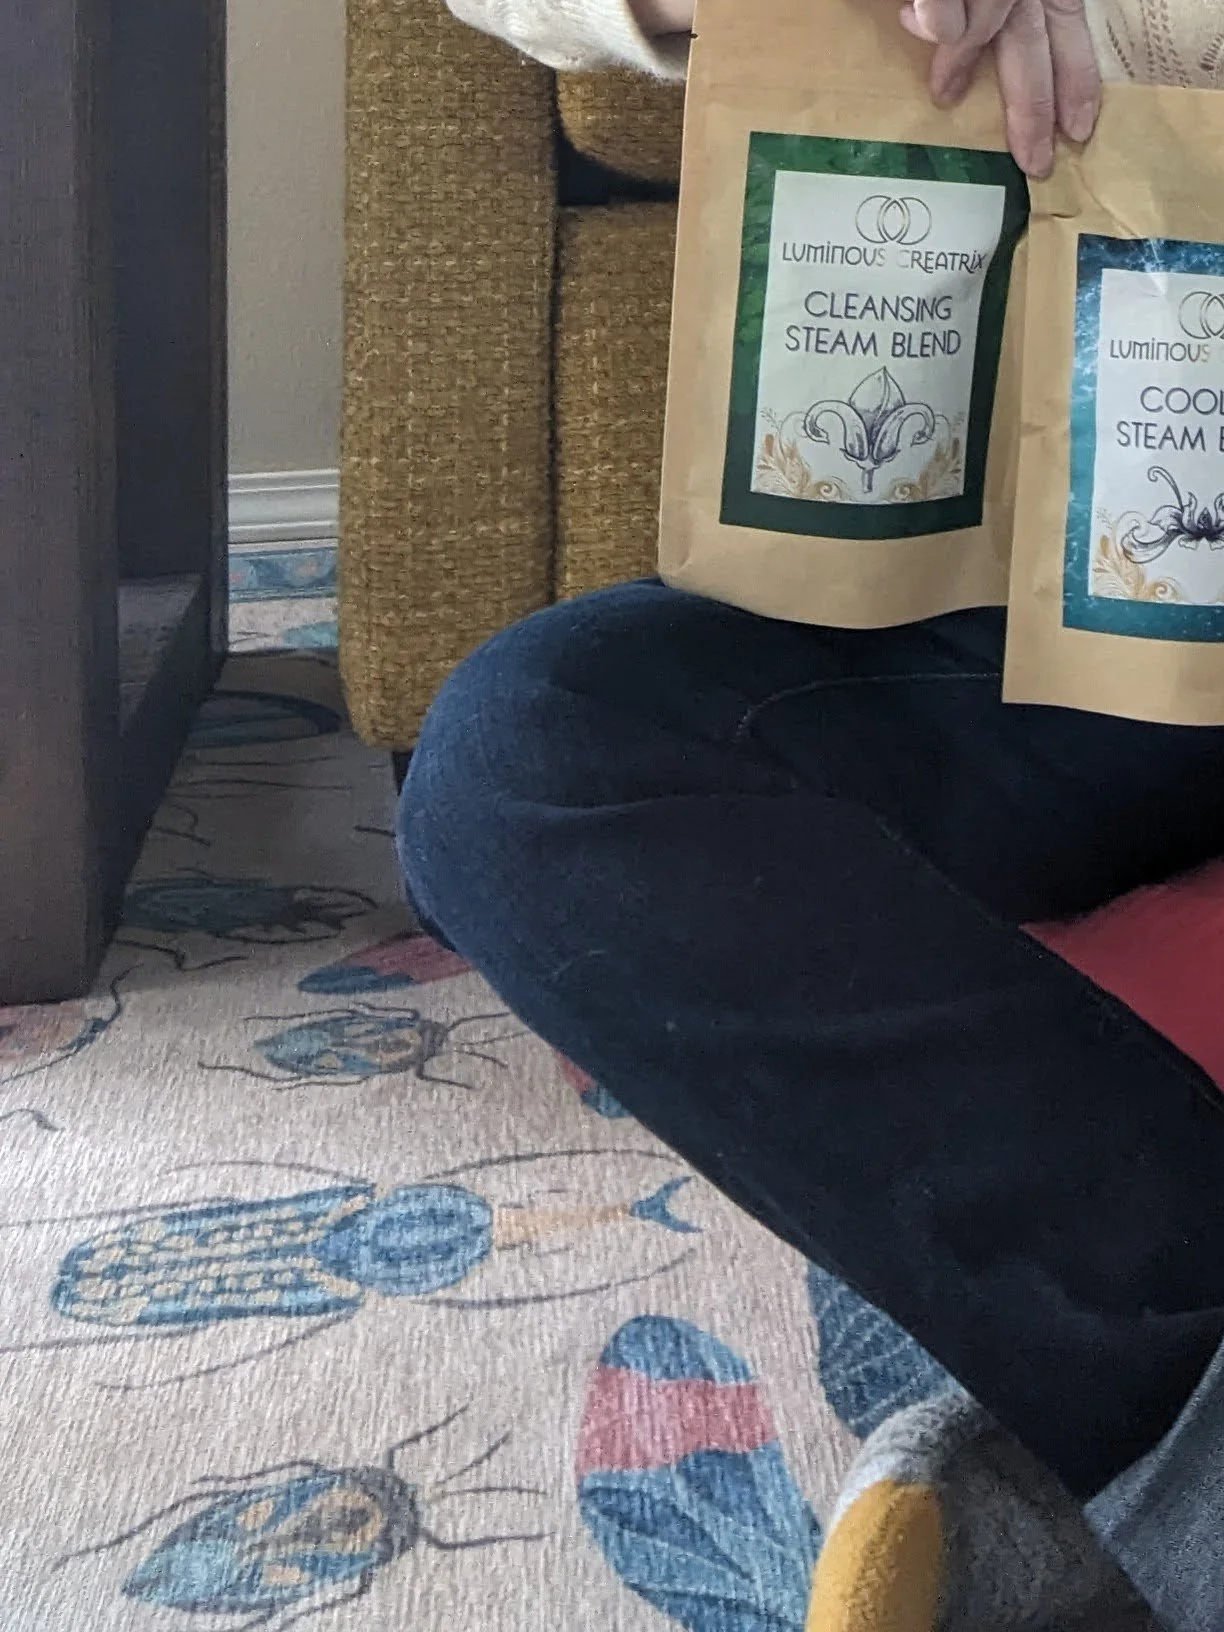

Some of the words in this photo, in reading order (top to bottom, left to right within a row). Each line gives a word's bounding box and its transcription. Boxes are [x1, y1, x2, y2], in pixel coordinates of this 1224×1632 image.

[804, 290, 953, 323] CLEANSING
[785, 325, 878, 357] STEAM
[891, 329, 961, 358] BLEND
[1116, 421, 1206, 452] STEAM
